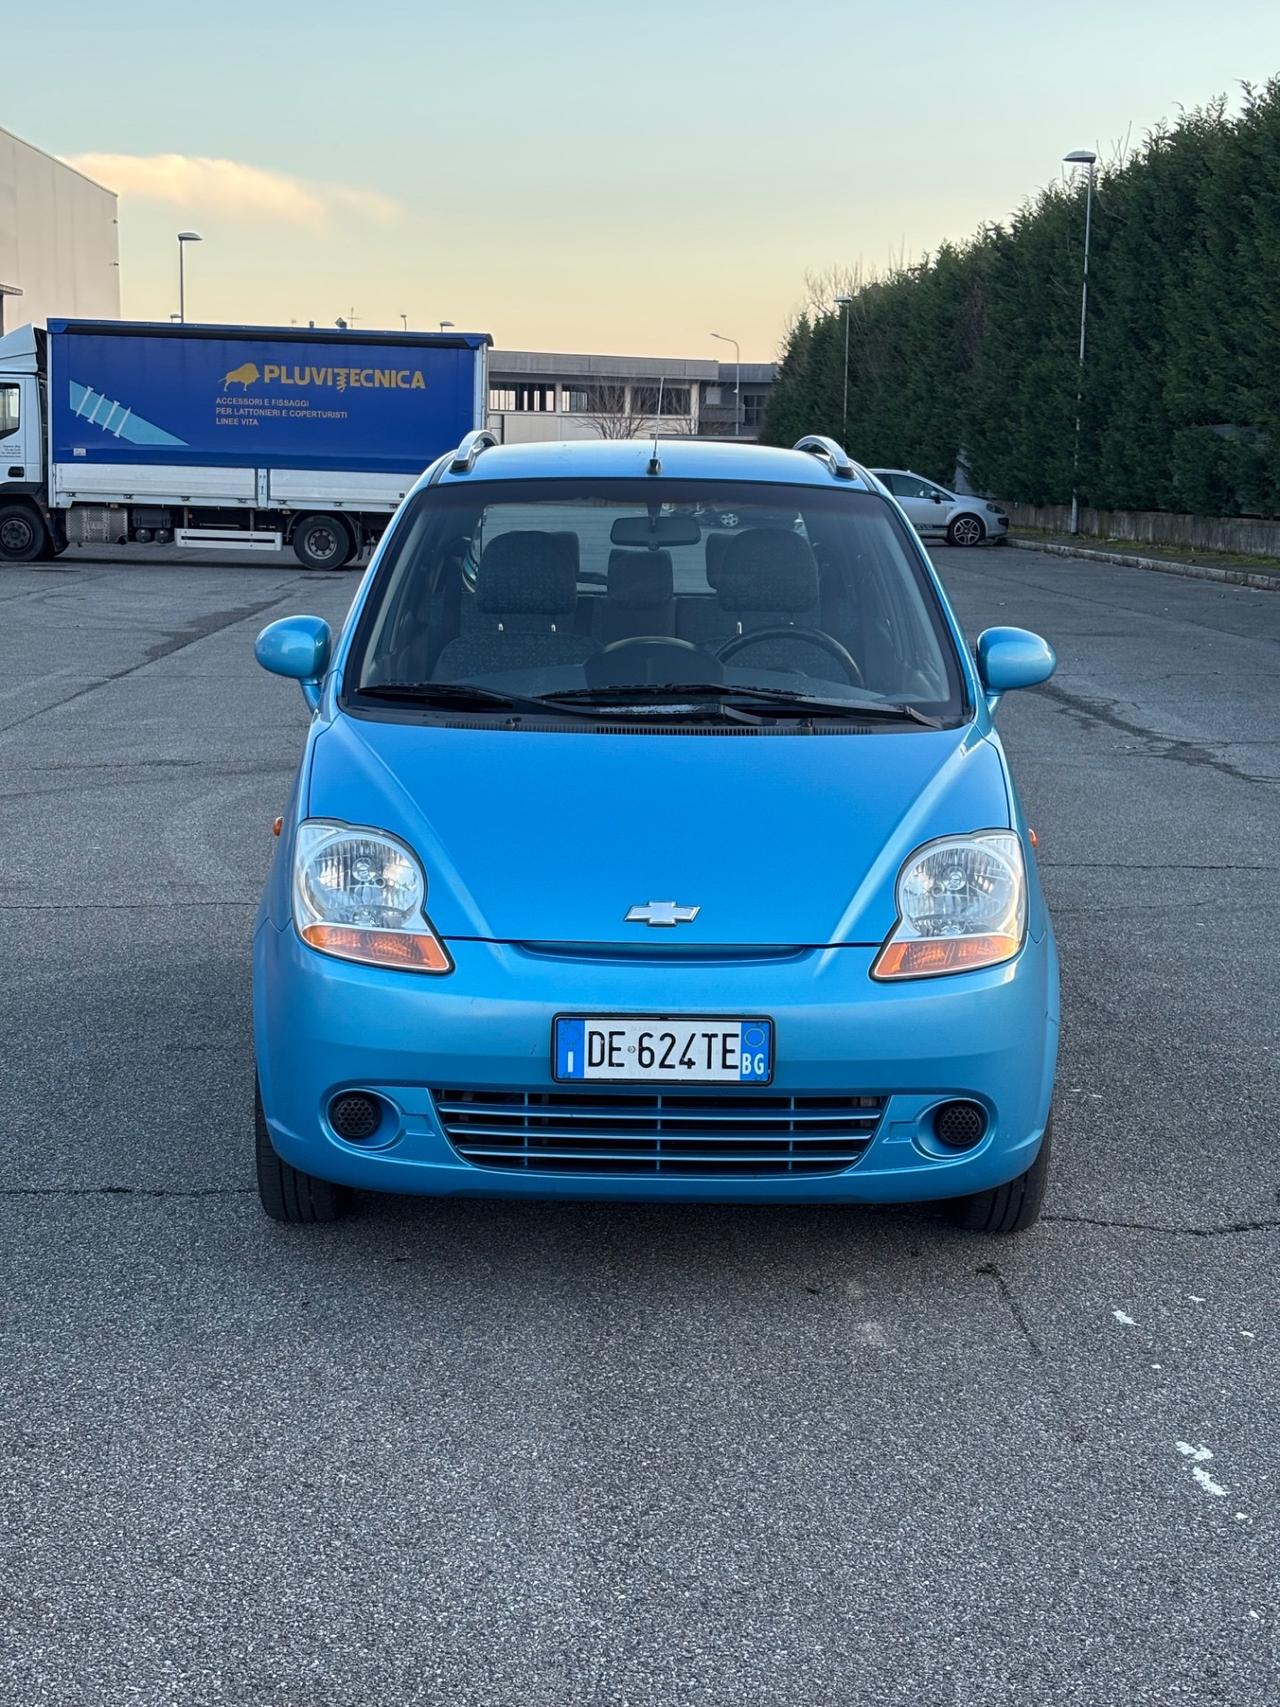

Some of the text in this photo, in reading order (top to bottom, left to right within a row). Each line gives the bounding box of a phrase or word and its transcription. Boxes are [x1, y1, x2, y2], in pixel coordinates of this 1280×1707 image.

[263, 364, 426, 392] PLUVITECNICA
[215, 397, 263, 406] ACCESSORI
[271, 399, 310, 407] FISSAGGI
[215, 407, 348, 419] PER LATTONIERI E COPERTURISTI
[215, 417, 259, 426] LINEE VITA
[742, 1053, 765, 1075] BG
